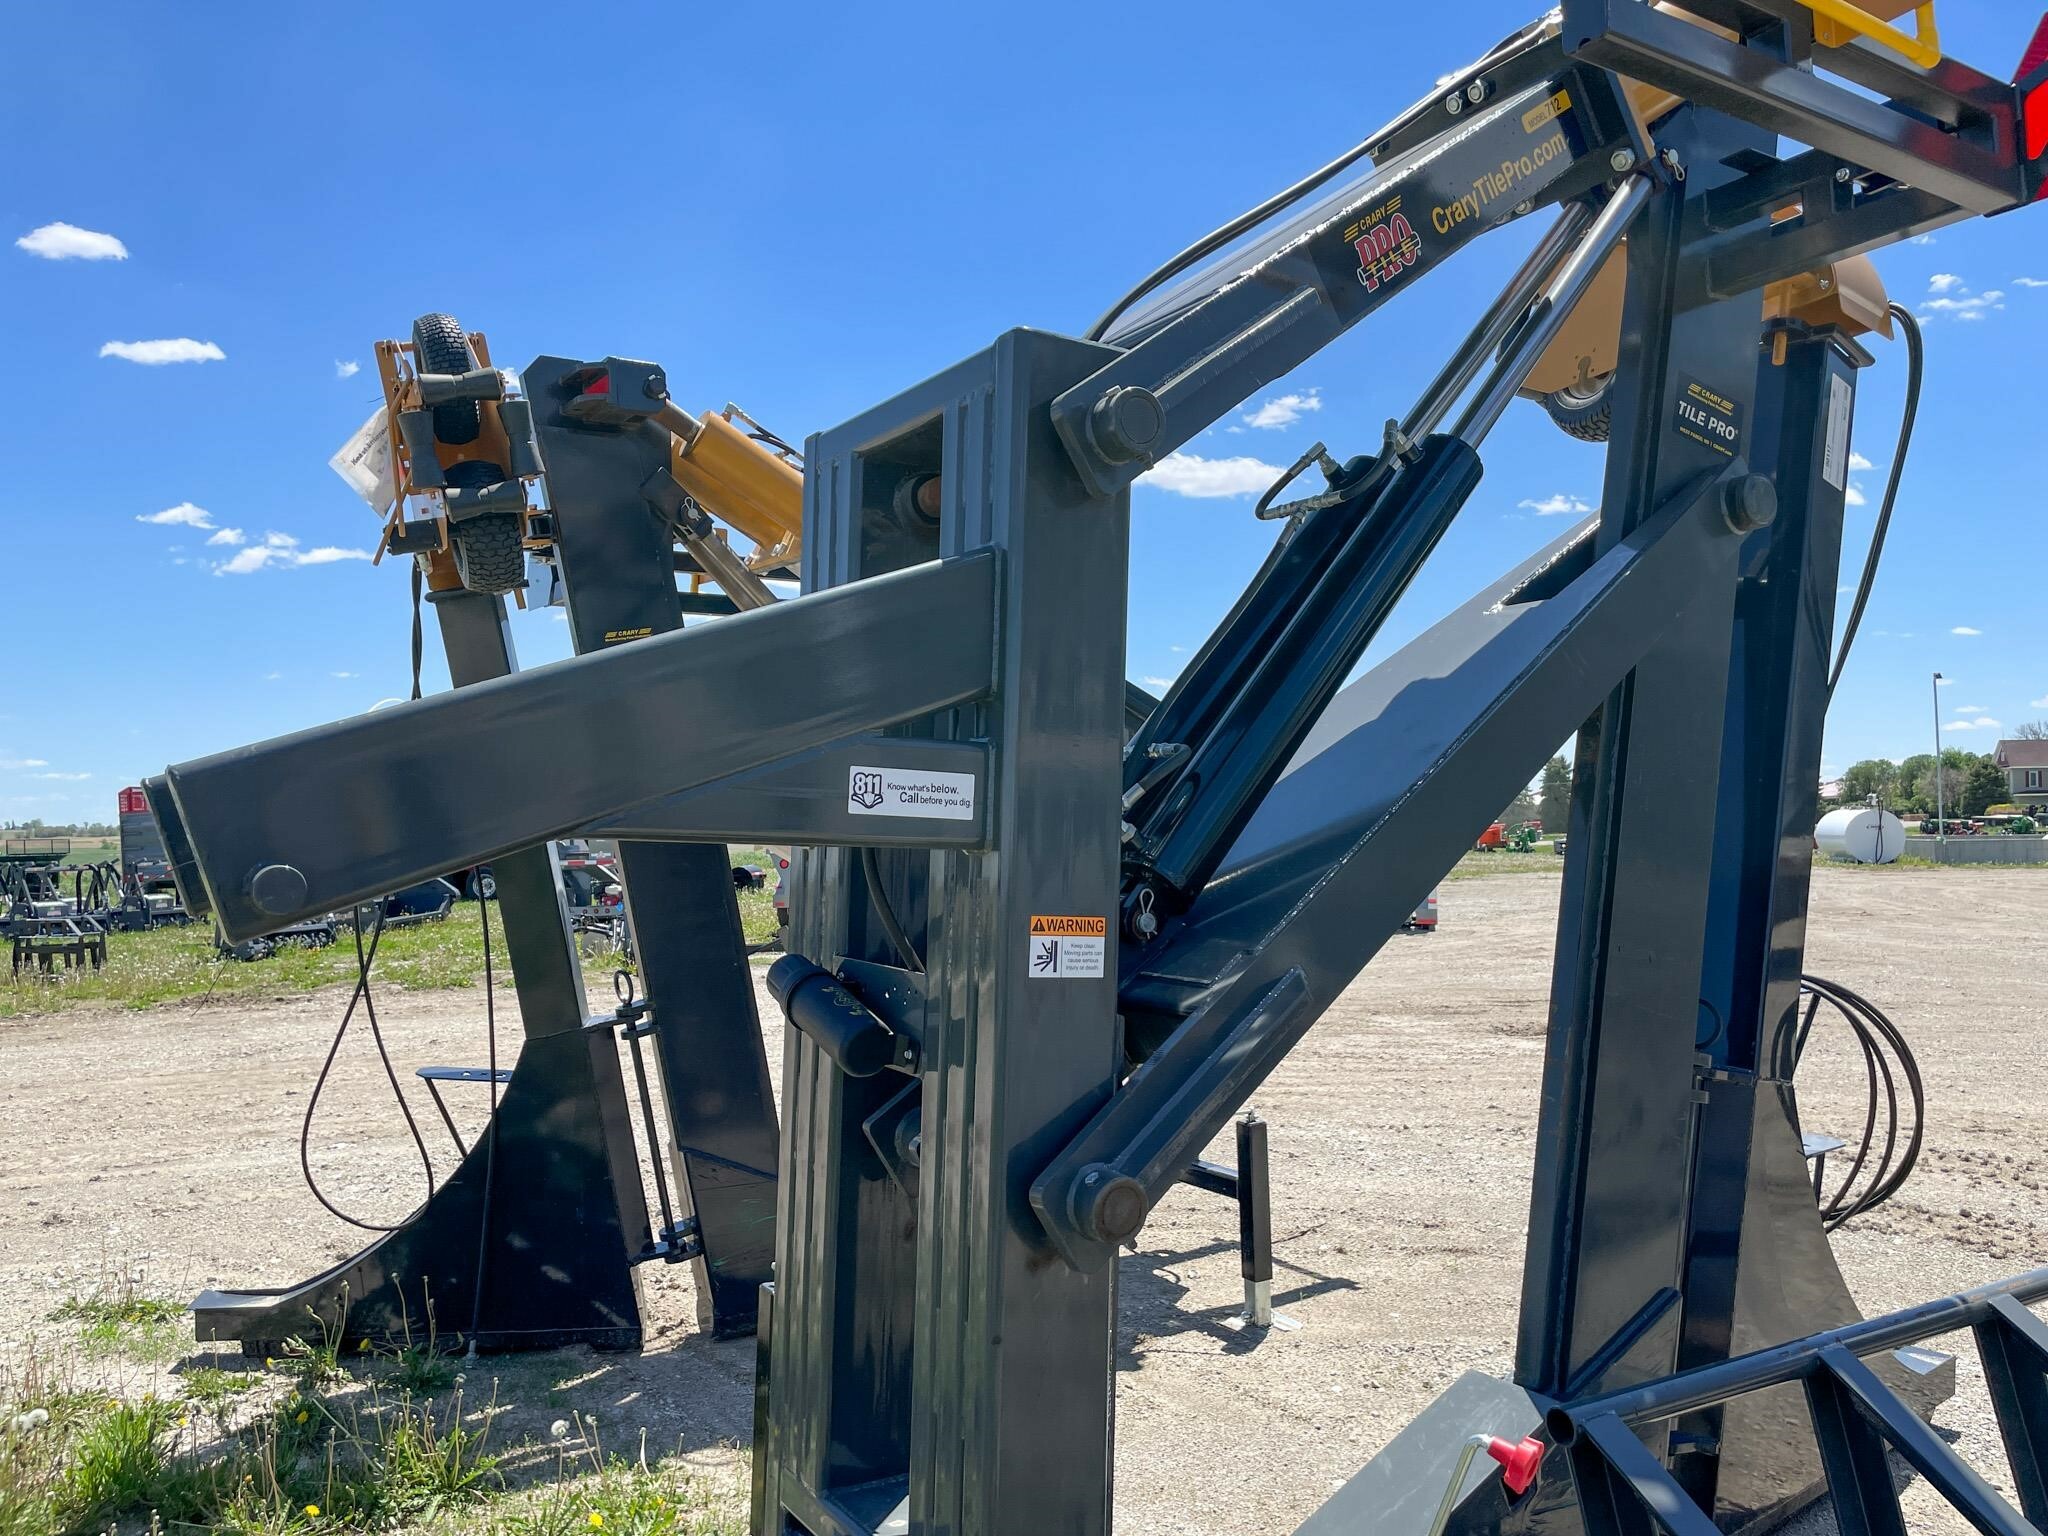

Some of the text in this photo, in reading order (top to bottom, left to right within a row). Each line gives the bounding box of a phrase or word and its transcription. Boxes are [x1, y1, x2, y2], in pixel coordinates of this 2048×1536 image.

[1545, 98, 1562, 117] 712
[1432, 133, 1568, 234] CraryTilePro.com
[1360, 205, 1386, 230] CRARY
[1701, 389, 1722, 404] CRARY
[1678, 400, 1707, 426] TILE
[618, 629, 639, 637] CRARY
[853, 772, 883, 795] 811
[887, 782, 959, 795] Know what's below.
[900, 791, 972, 808] Call before you dig.
[1046, 918, 1104, 933] WARNING
